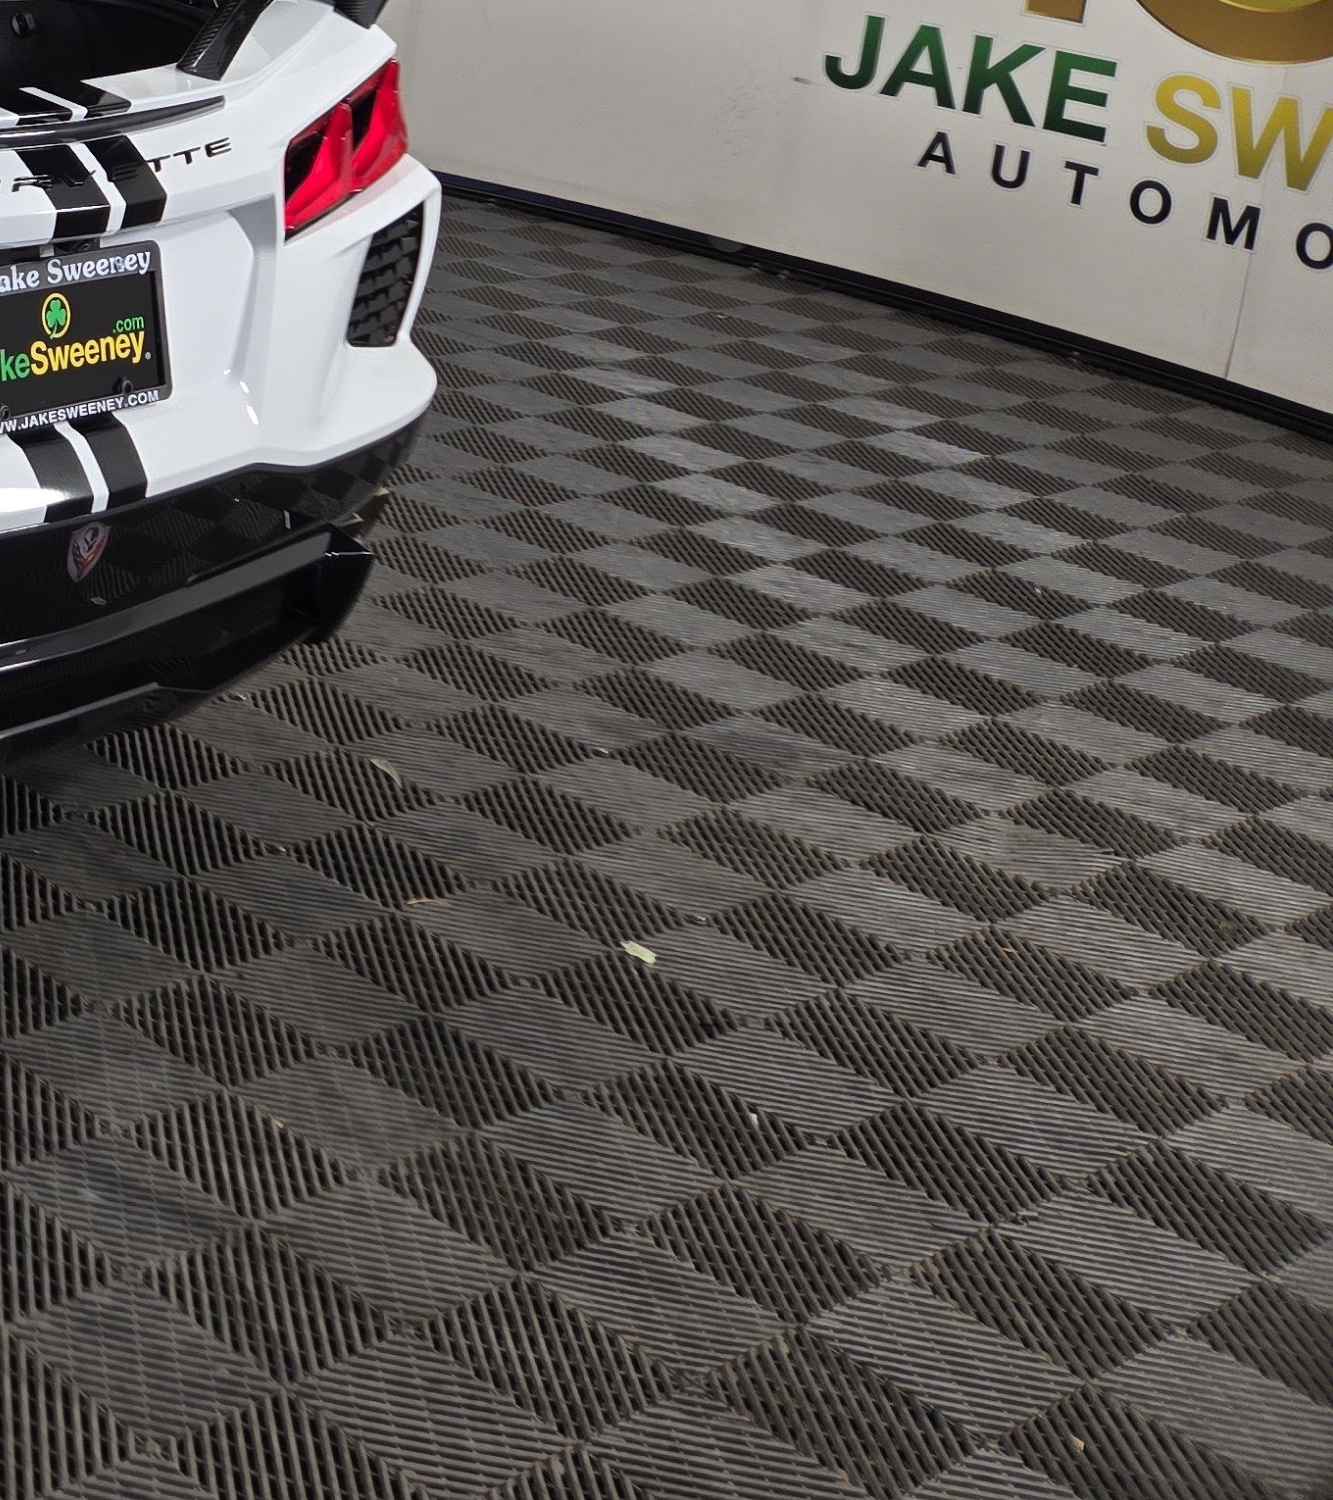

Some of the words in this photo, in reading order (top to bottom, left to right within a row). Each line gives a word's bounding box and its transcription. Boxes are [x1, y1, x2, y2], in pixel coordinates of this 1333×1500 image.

[824, 15, 1117, 143] JAKE
[47, 251, 151, 285] Sweeney
[112, 315, 145, 334] .com
